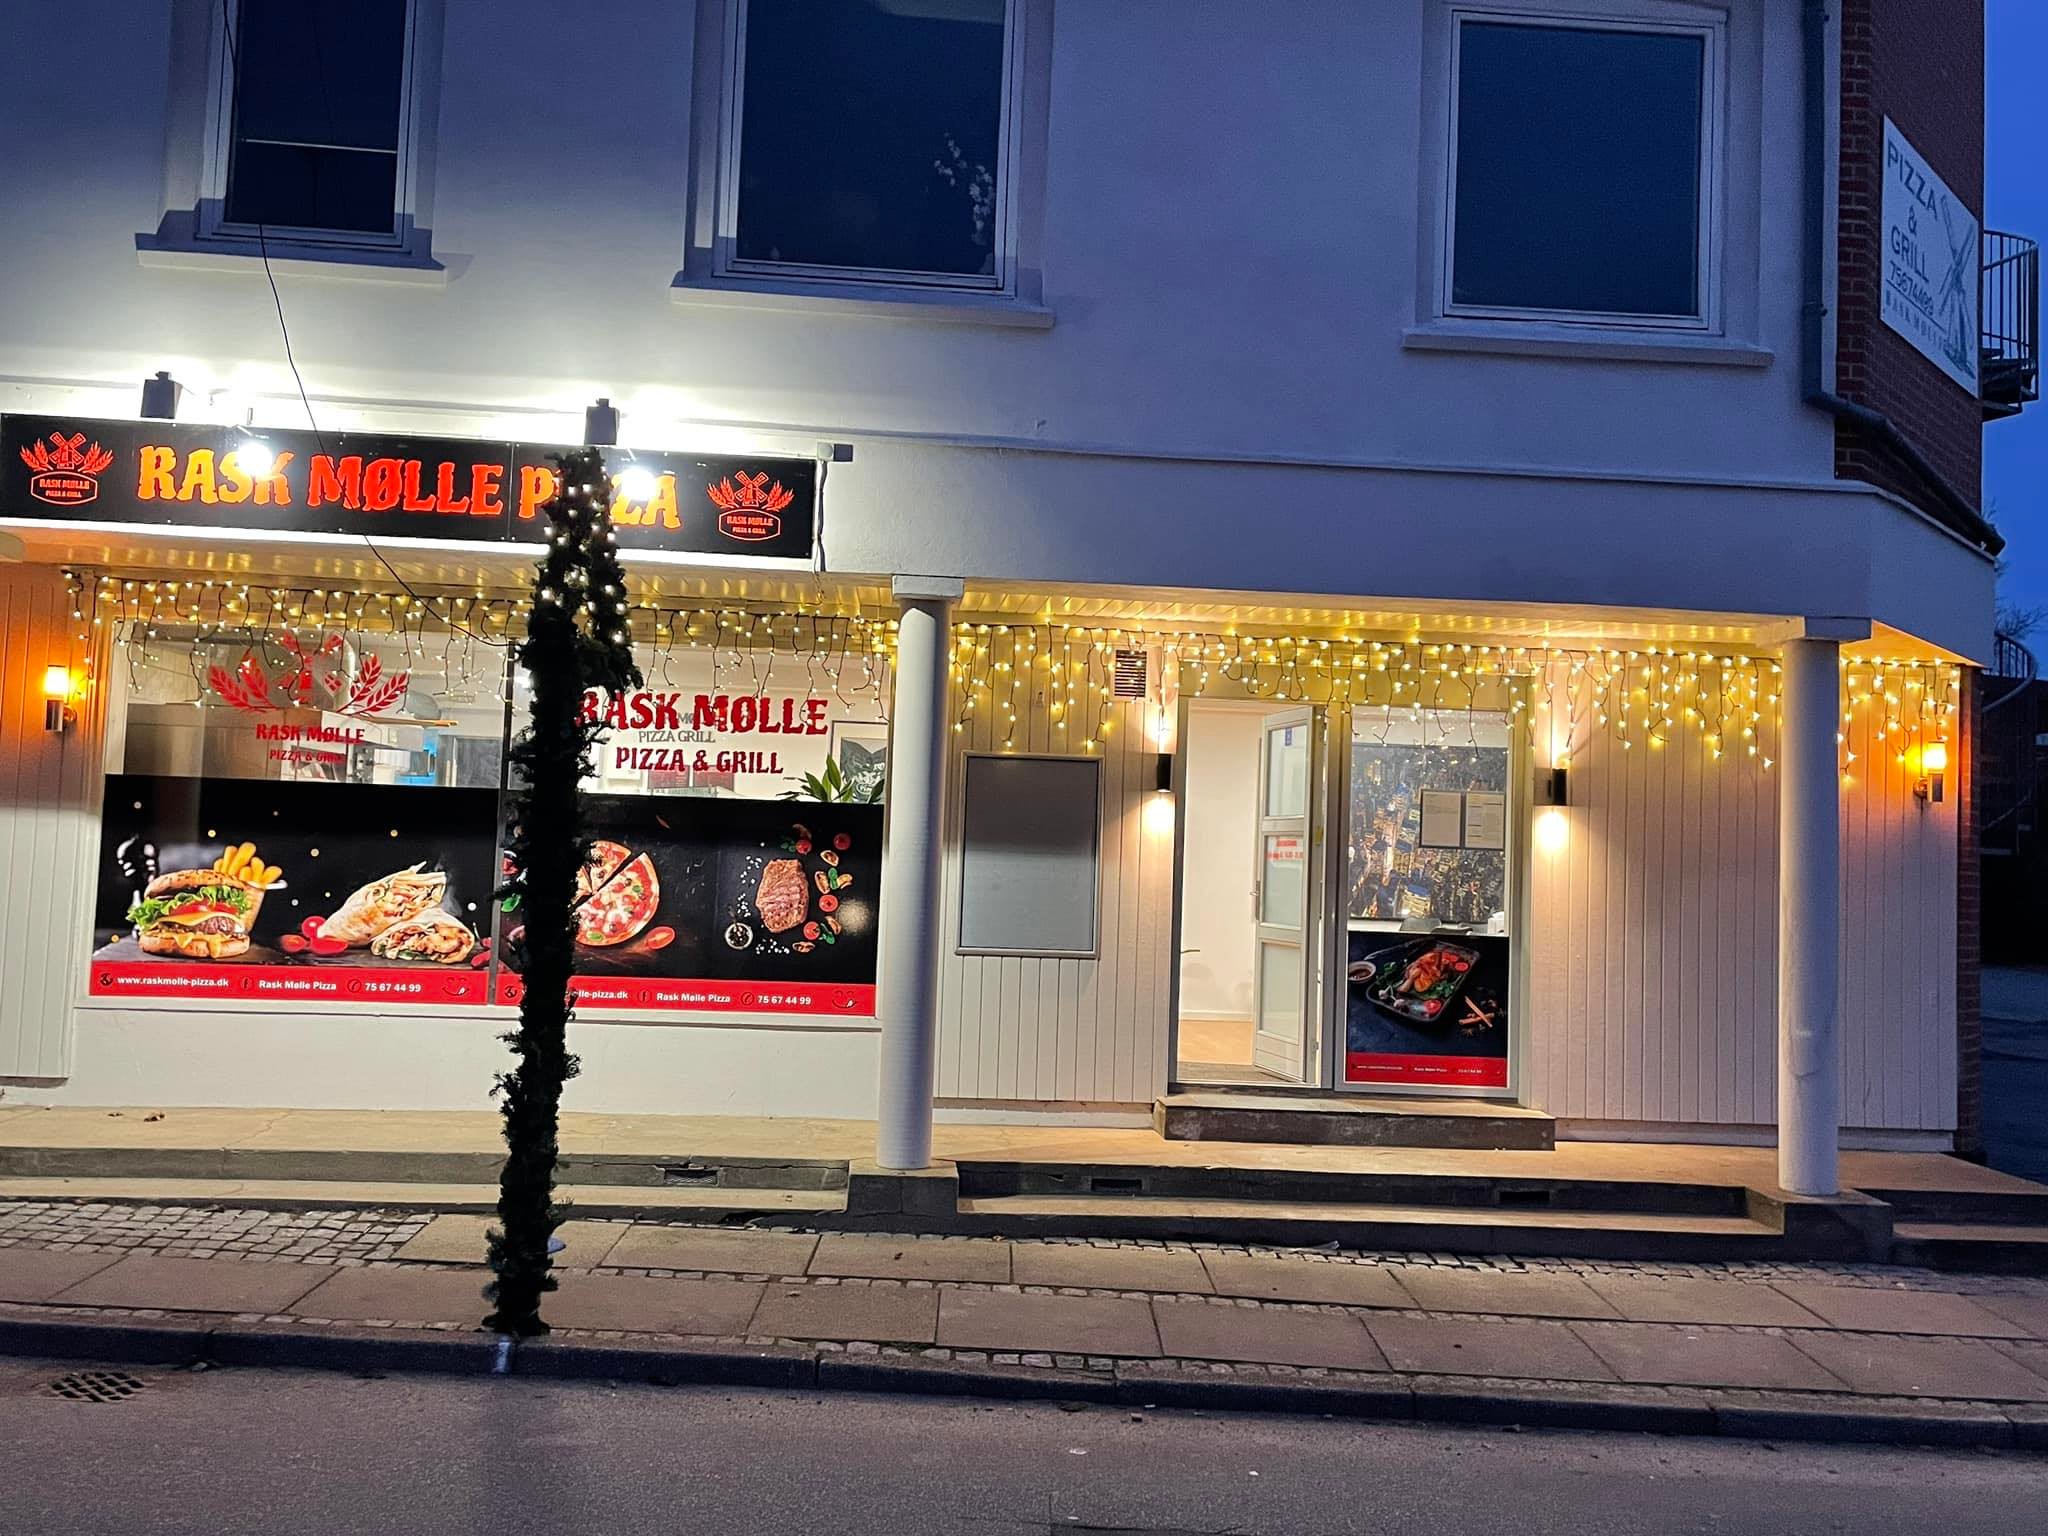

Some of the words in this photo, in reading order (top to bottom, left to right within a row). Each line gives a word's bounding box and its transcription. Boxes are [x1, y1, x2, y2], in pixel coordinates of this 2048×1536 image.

[1887, 138, 1938, 221] PIZZA
[1907, 205, 1917, 236] &
[1890, 225, 1929, 283] GRILL
[137, 445, 295, 506] RASK
[307, 454, 504, 515] MØLLE
[518, 465, 682, 529] PZA
[575, 691, 681, 730] RASK
[692, 694, 828, 735] MØLLE
[255, 723, 301, 741] RASK
[306, 726, 365, 744] MØLLE
[639, 731, 676, 743] PIZZA
[677, 731, 716, 743] GRILL
[269, 749, 302, 761] PIZZA
[305, 751, 312, 761] &
[615, 746, 686, 772] PIZZA
[692, 750, 709, 772] &
[716, 750, 784, 774] GRILL
[259, 980, 282, 989] Rask
[313, 981, 337, 991] Pizza
[364, 982, 377, 991] 75
[379, 983, 391, 992] 67
[393, 983, 406, 992] 44
[408, 984, 421, 993] 99
[656, 992, 679, 1002] Rask
[708, 994, 731, 1003] Pizza
[757, 995, 769, 1004] 75
[771, 995, 783, 1004] 67
[785, 996, 797, 1005] 44
[799, 996, 812, 1005] 99
